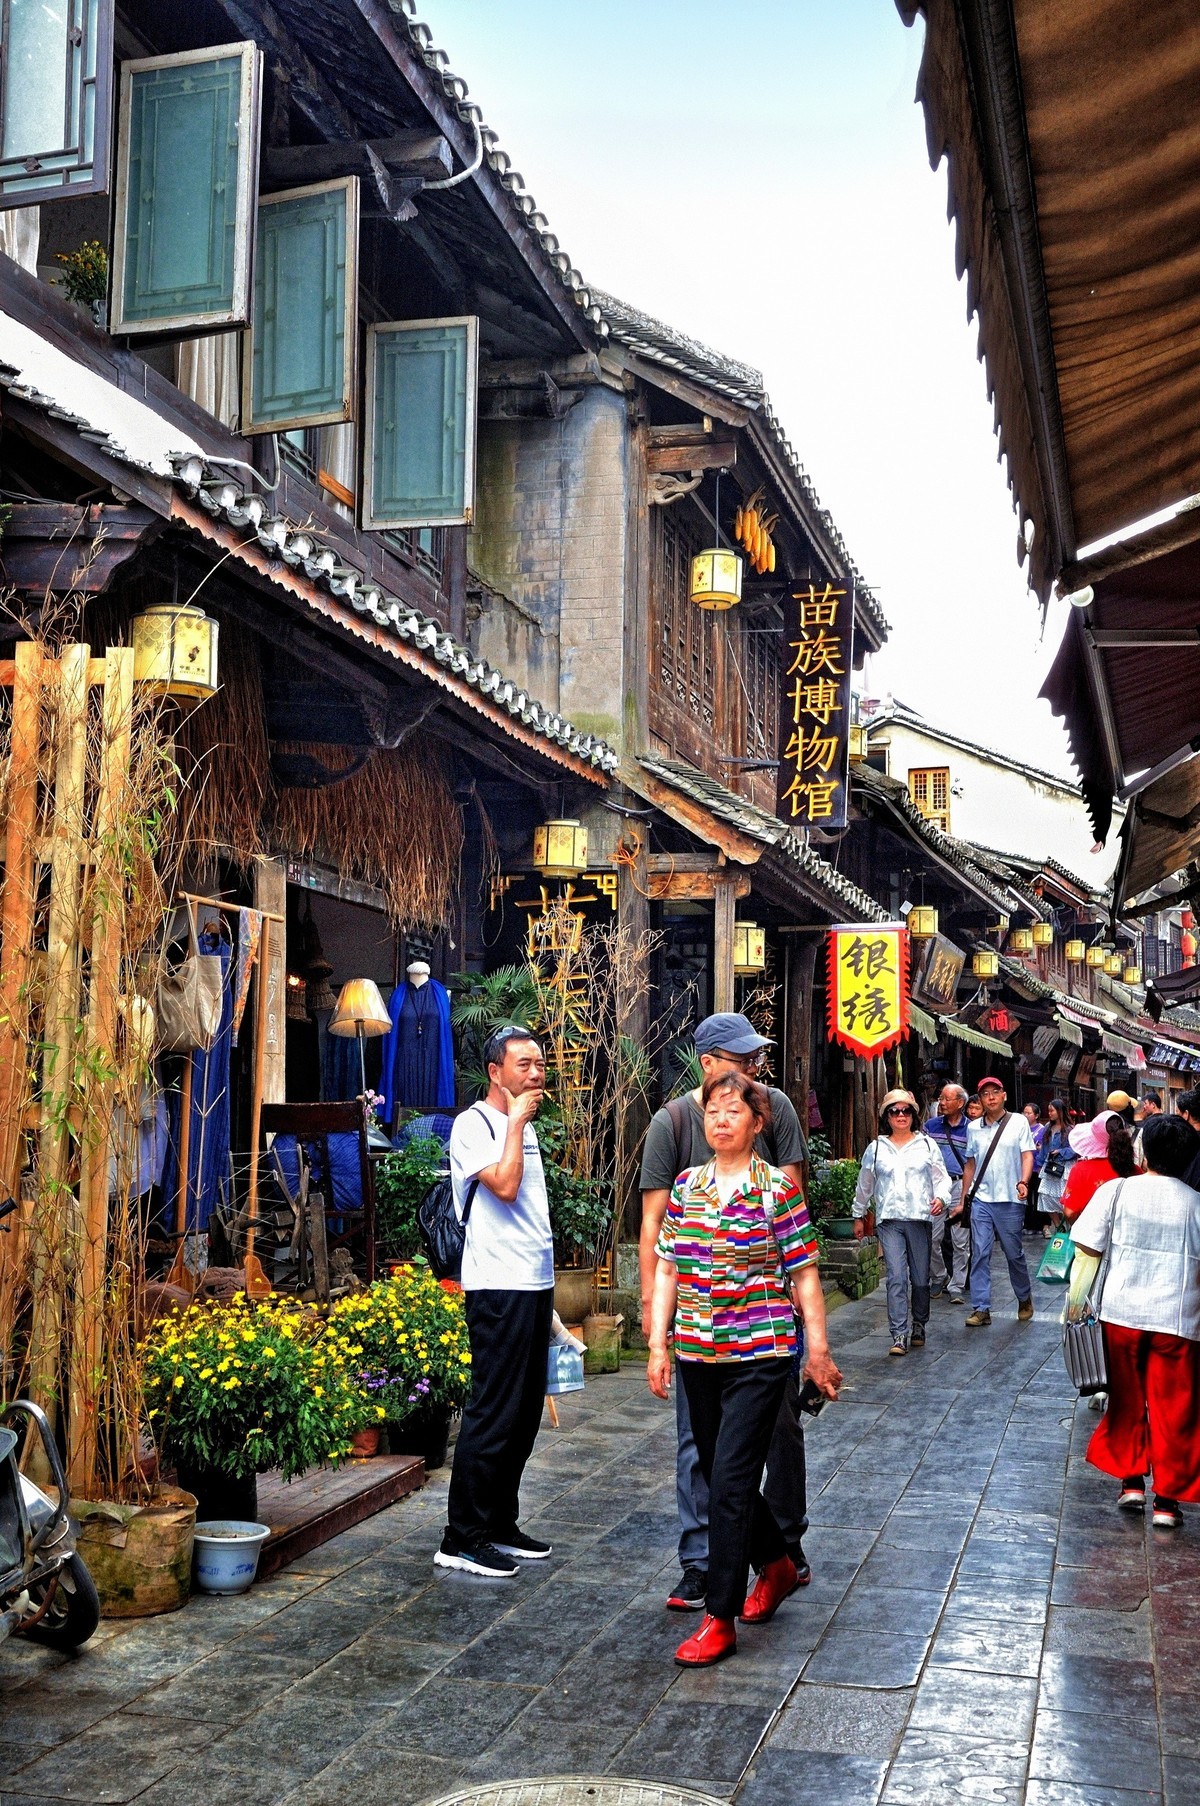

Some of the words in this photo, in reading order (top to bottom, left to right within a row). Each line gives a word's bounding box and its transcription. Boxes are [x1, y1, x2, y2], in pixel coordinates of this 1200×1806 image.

[781, 582, 847, 822] 苗族博物馆
